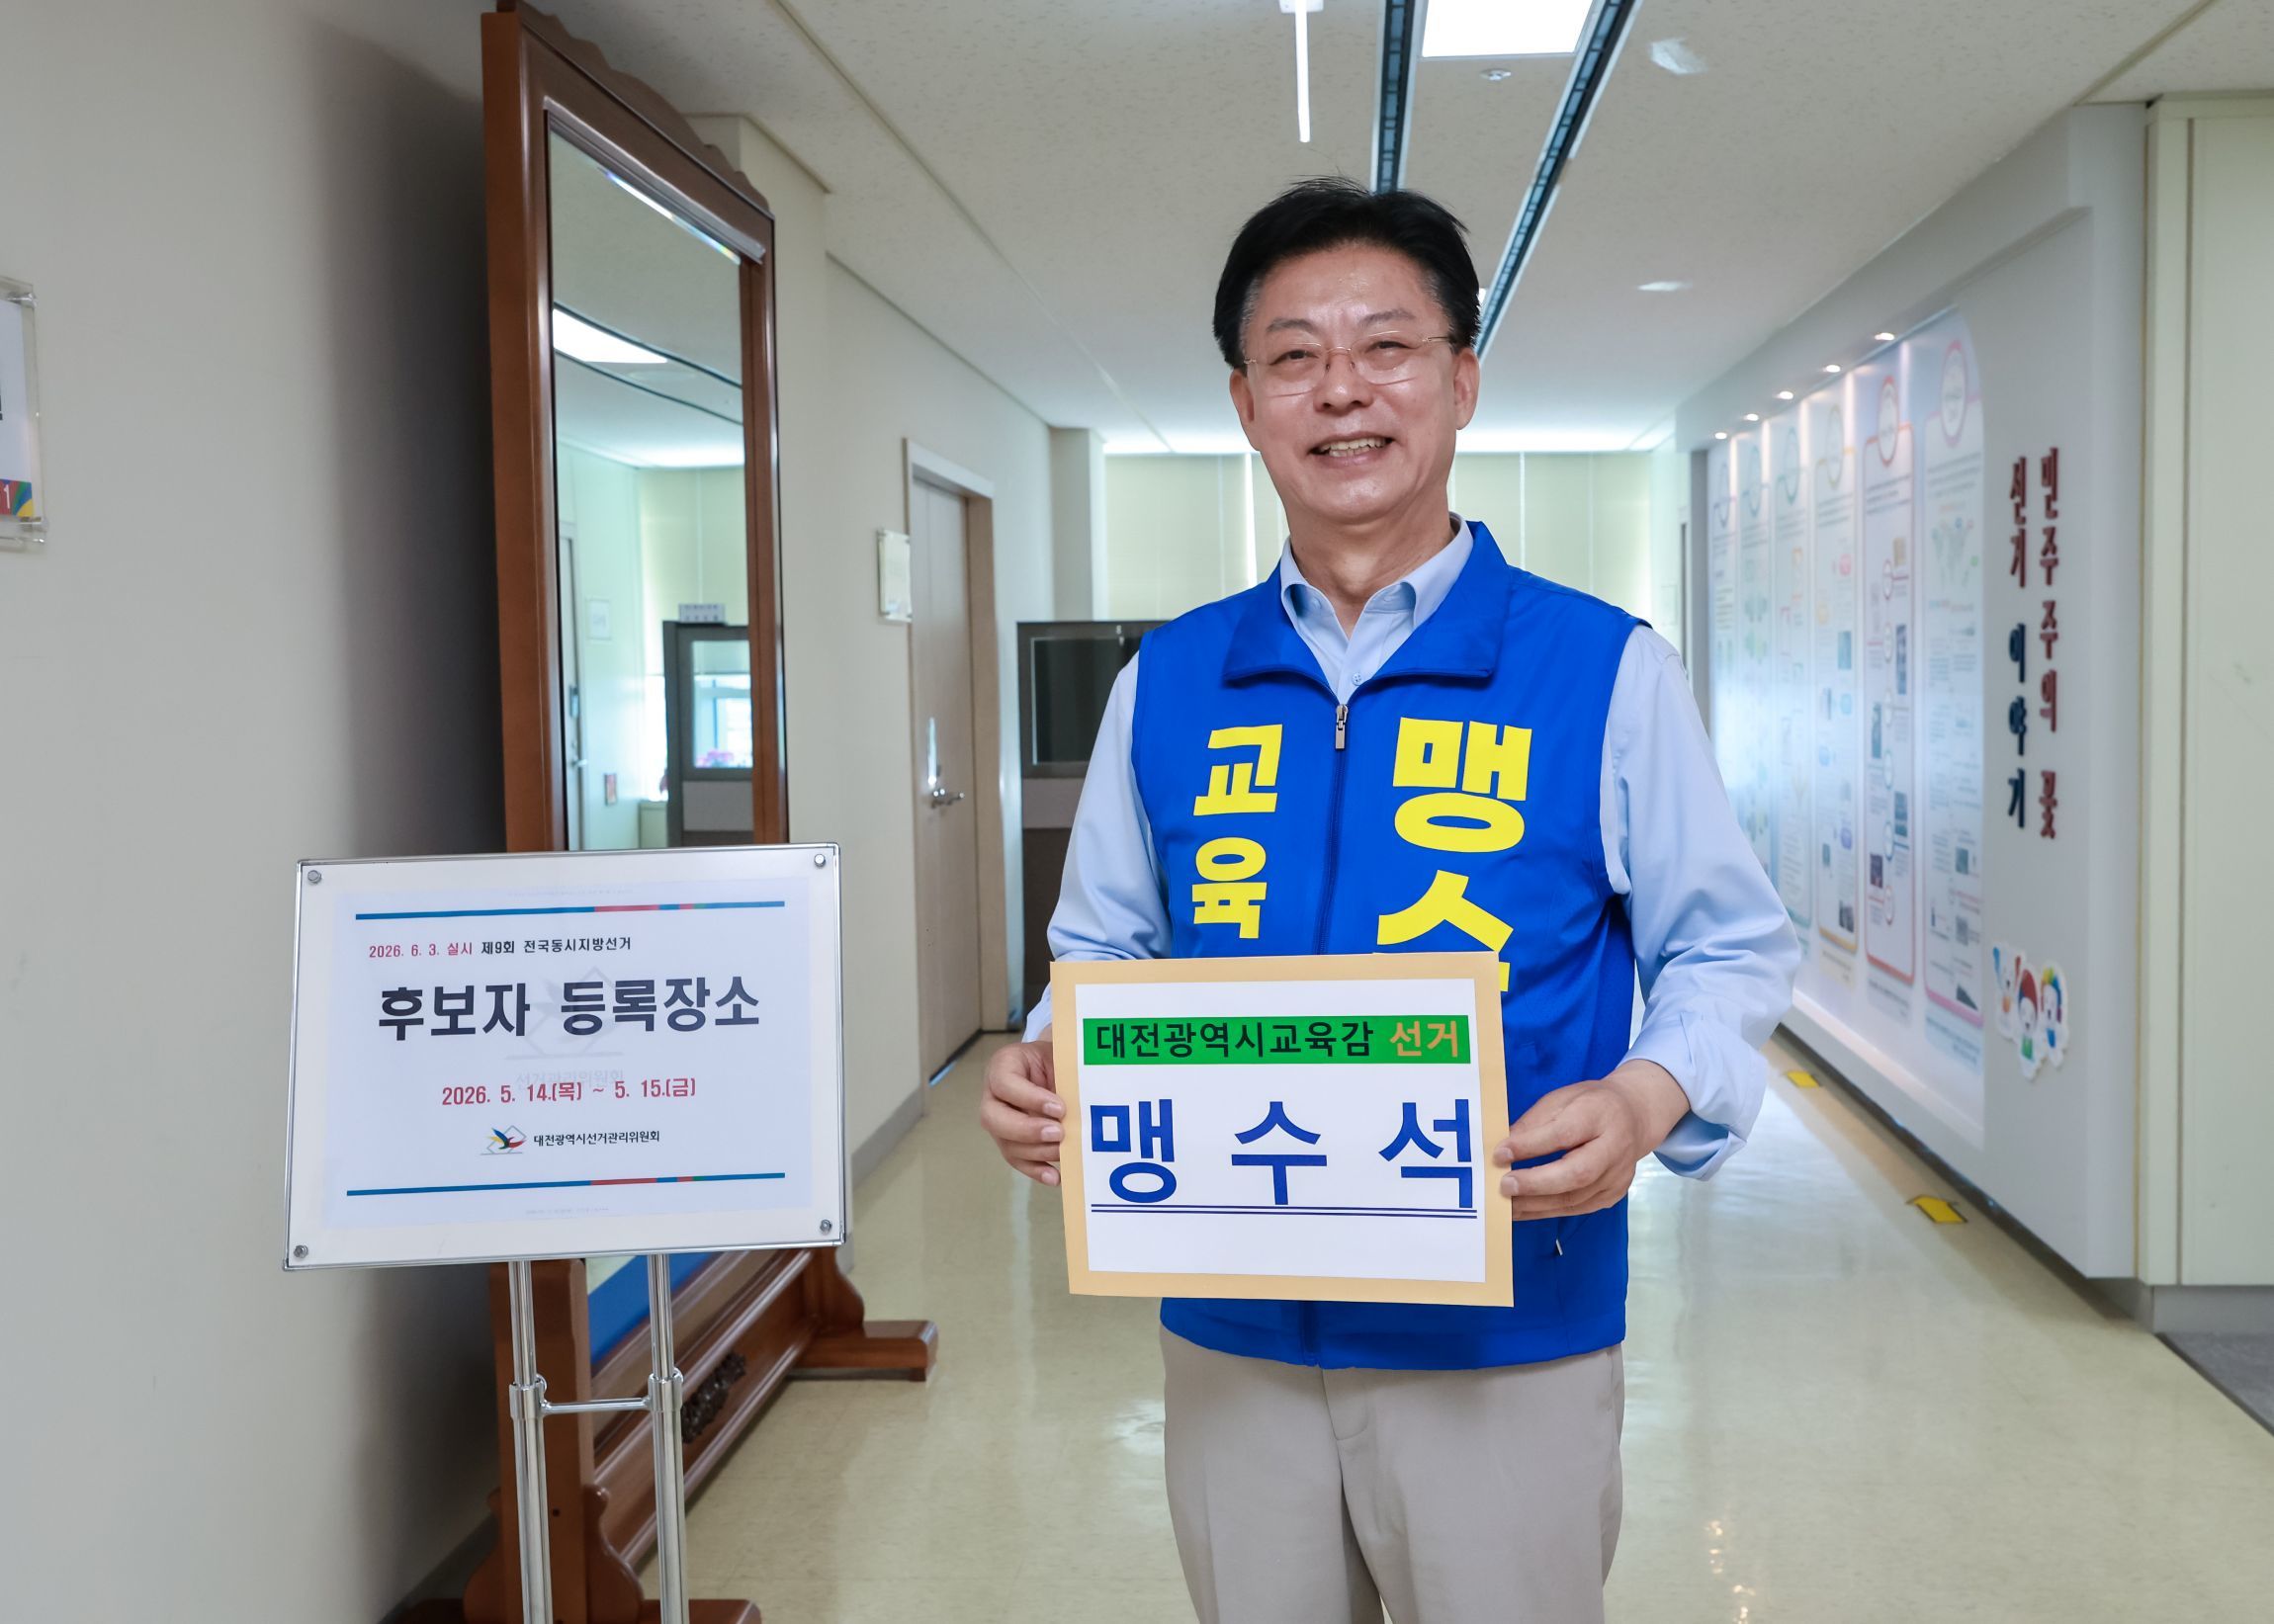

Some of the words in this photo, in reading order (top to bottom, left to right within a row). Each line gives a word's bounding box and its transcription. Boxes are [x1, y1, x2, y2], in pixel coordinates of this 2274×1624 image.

[2009, 456, 2028, 589] 선거
[2039, 447, 2059, 733] 민주주의
[2007, 622, 2028, 830] 이야기
[1192, 725, 1282, 938] 교육
[2039, 770, 2058, 840] 꽃
[369, 944, 404, 959] 2026.
[410, 944, 422, 957] 6.
[428, 943, 440, 957] 3.
[447, 942, 473, 957] 실시
[481, 940, 515, 955] 제9회
[523, 936, 631, 954] 전국동시지방선거
[378, 982, 531, 1042] 후보자
[560, 976, 760, 1037] 등록장소
[1096, 1020, 1374, 1059] 대전광역시교육감
[1390, 1020, 1458, 1057] 선거
[442, 1085, 491, 1106] 2026.
[500, 1084, 516, 1104] 5.
[527, 1081, 582, 1102] 14.(목)
[614, 1080, 630, 1099] 5.
[641, 1077, 696, 1098] 15.(금)
[533, 1130, 660, 1148] 대전광역시선거관리위원회
